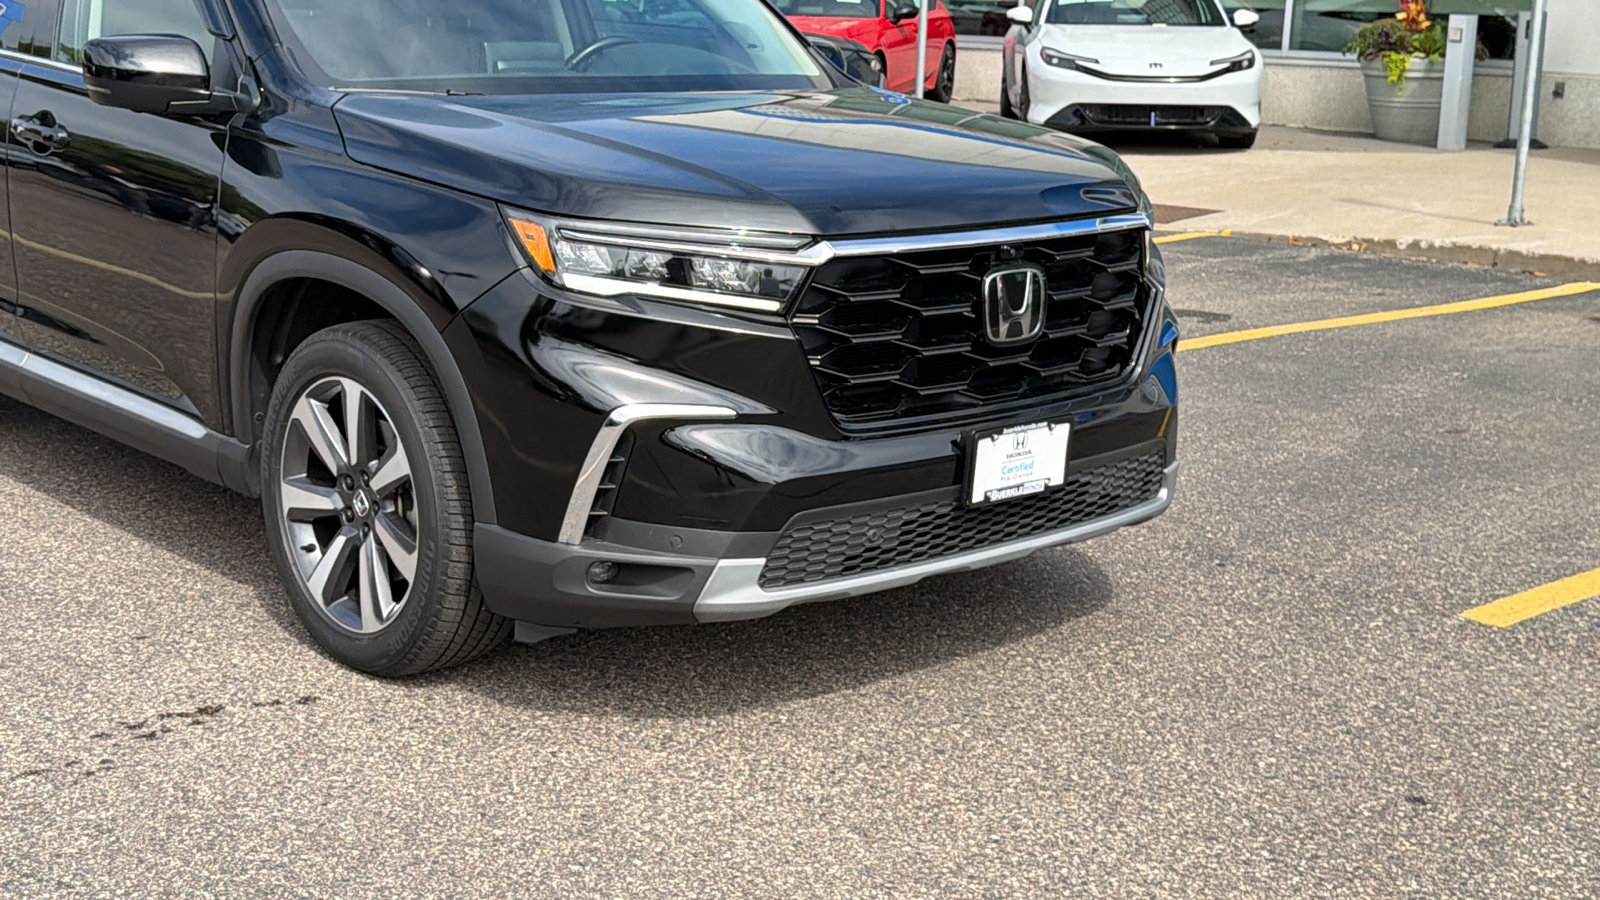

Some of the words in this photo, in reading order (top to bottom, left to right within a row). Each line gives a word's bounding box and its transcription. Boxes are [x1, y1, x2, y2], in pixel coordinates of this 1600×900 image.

[1006, 449, 1032, 459] HONDA
[1001, 460, 1034, 475] Certified
[386, 537, 435, 656] BRIDGESTONE
